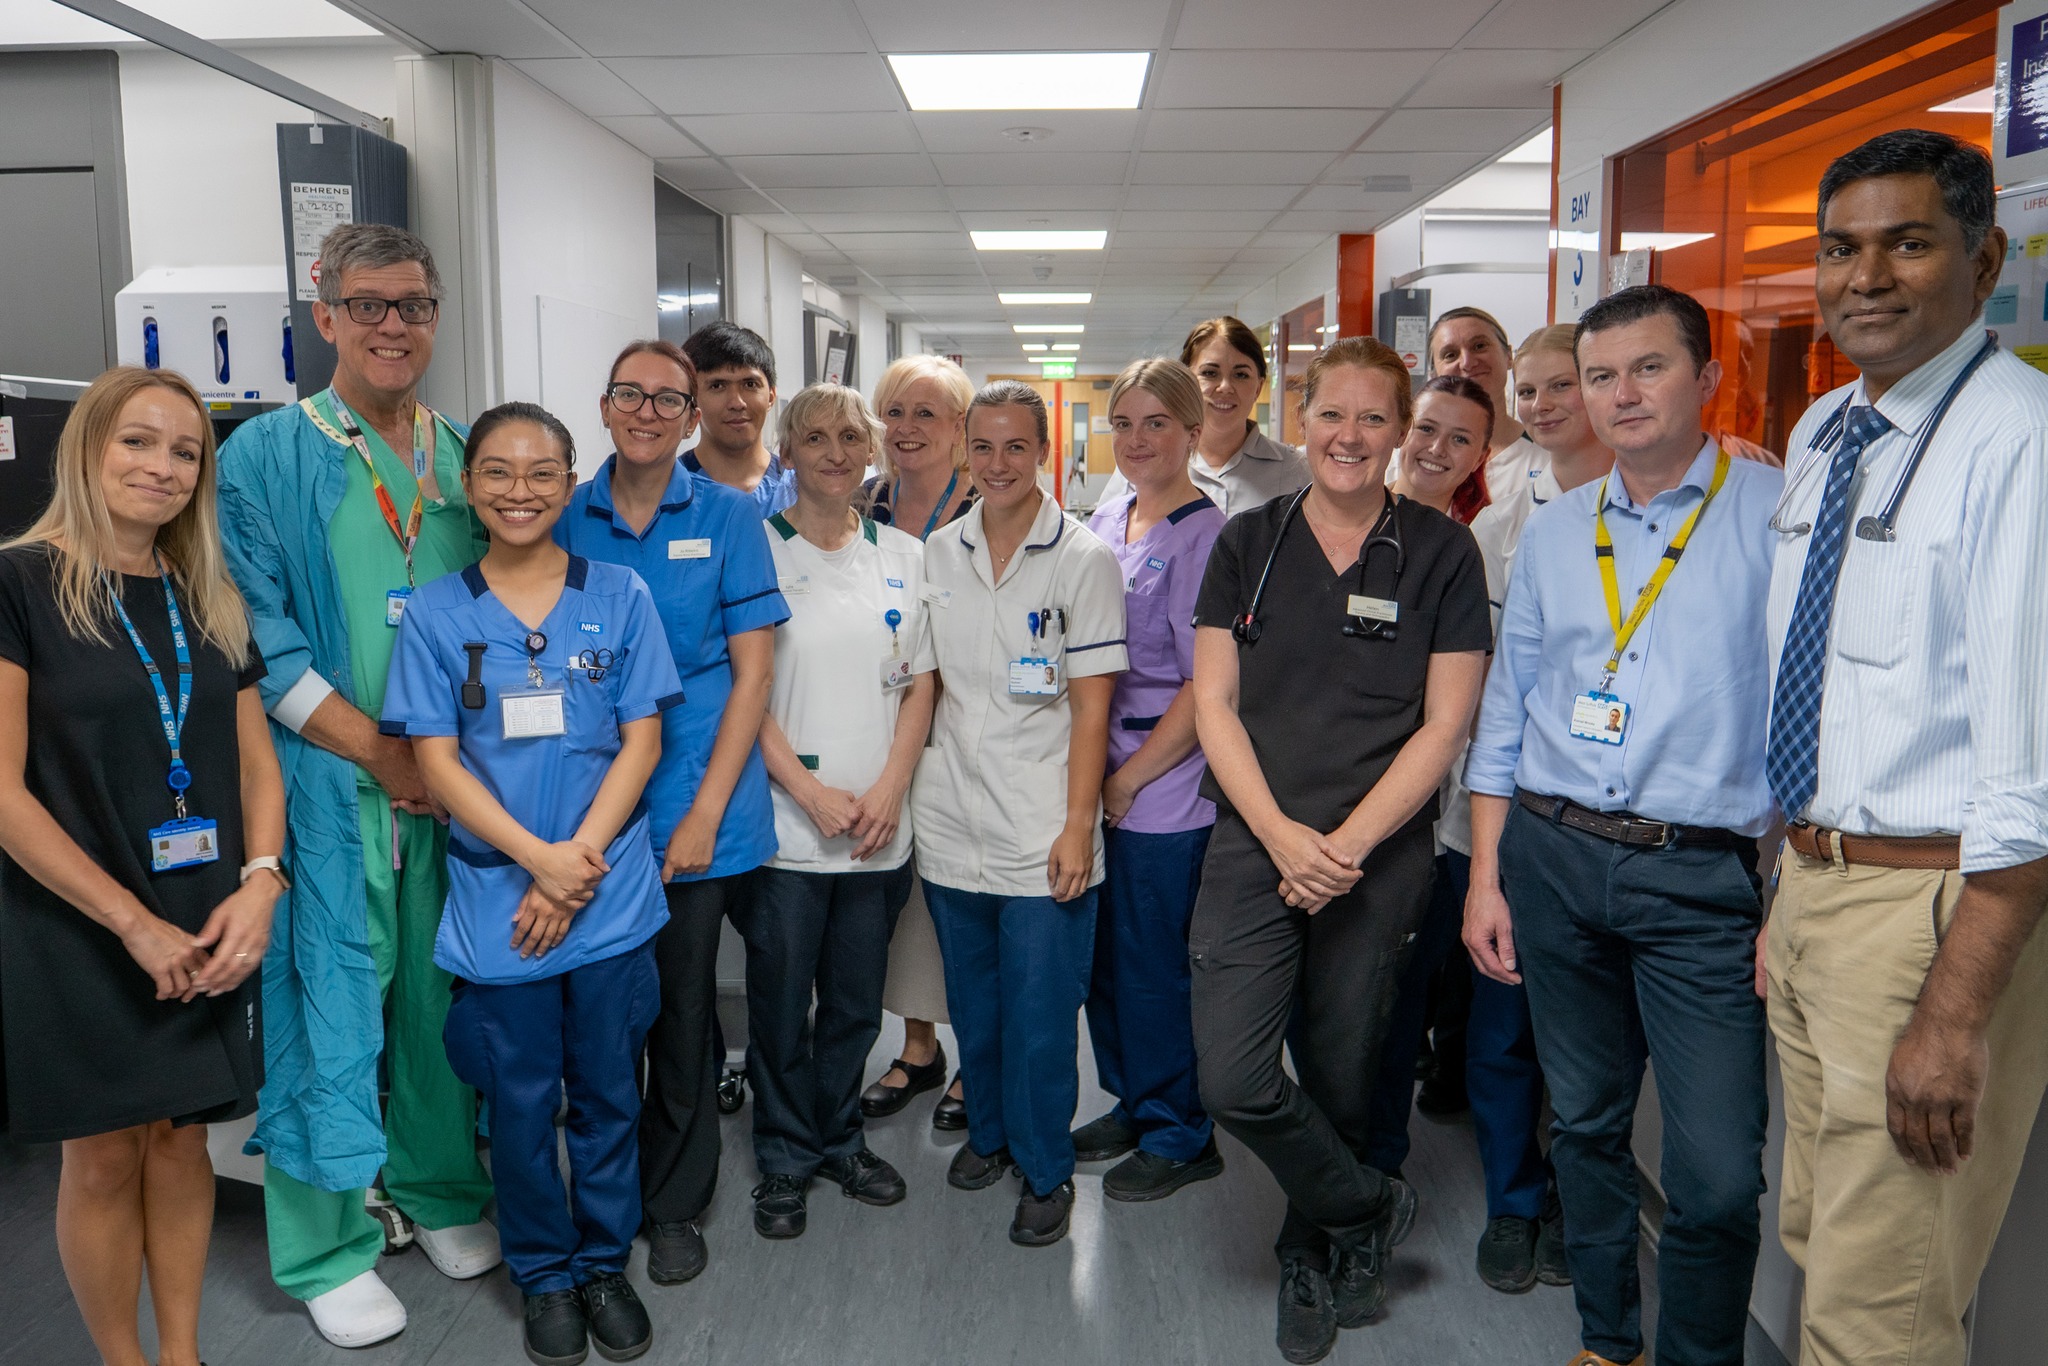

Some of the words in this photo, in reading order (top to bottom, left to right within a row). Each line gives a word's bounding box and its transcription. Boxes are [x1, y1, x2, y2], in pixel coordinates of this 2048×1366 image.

[293, 186, 349, 195] BEHRENS
[1571, 191, 1590, 222] BAY
[1149, 559, 1164, 570] NHS
[889, 579, 901, 587] NHS
[169, 609, 180, 628] NHS
[581, 623, 600, 633] NHS
[129, 629, 142, 648] NHS
[174, 631, 185, 648] NHS
[158, 694, 171, 715] NHS
[180, 692, 189, 714] NHS
[164, 720, 177, 741] NHS
